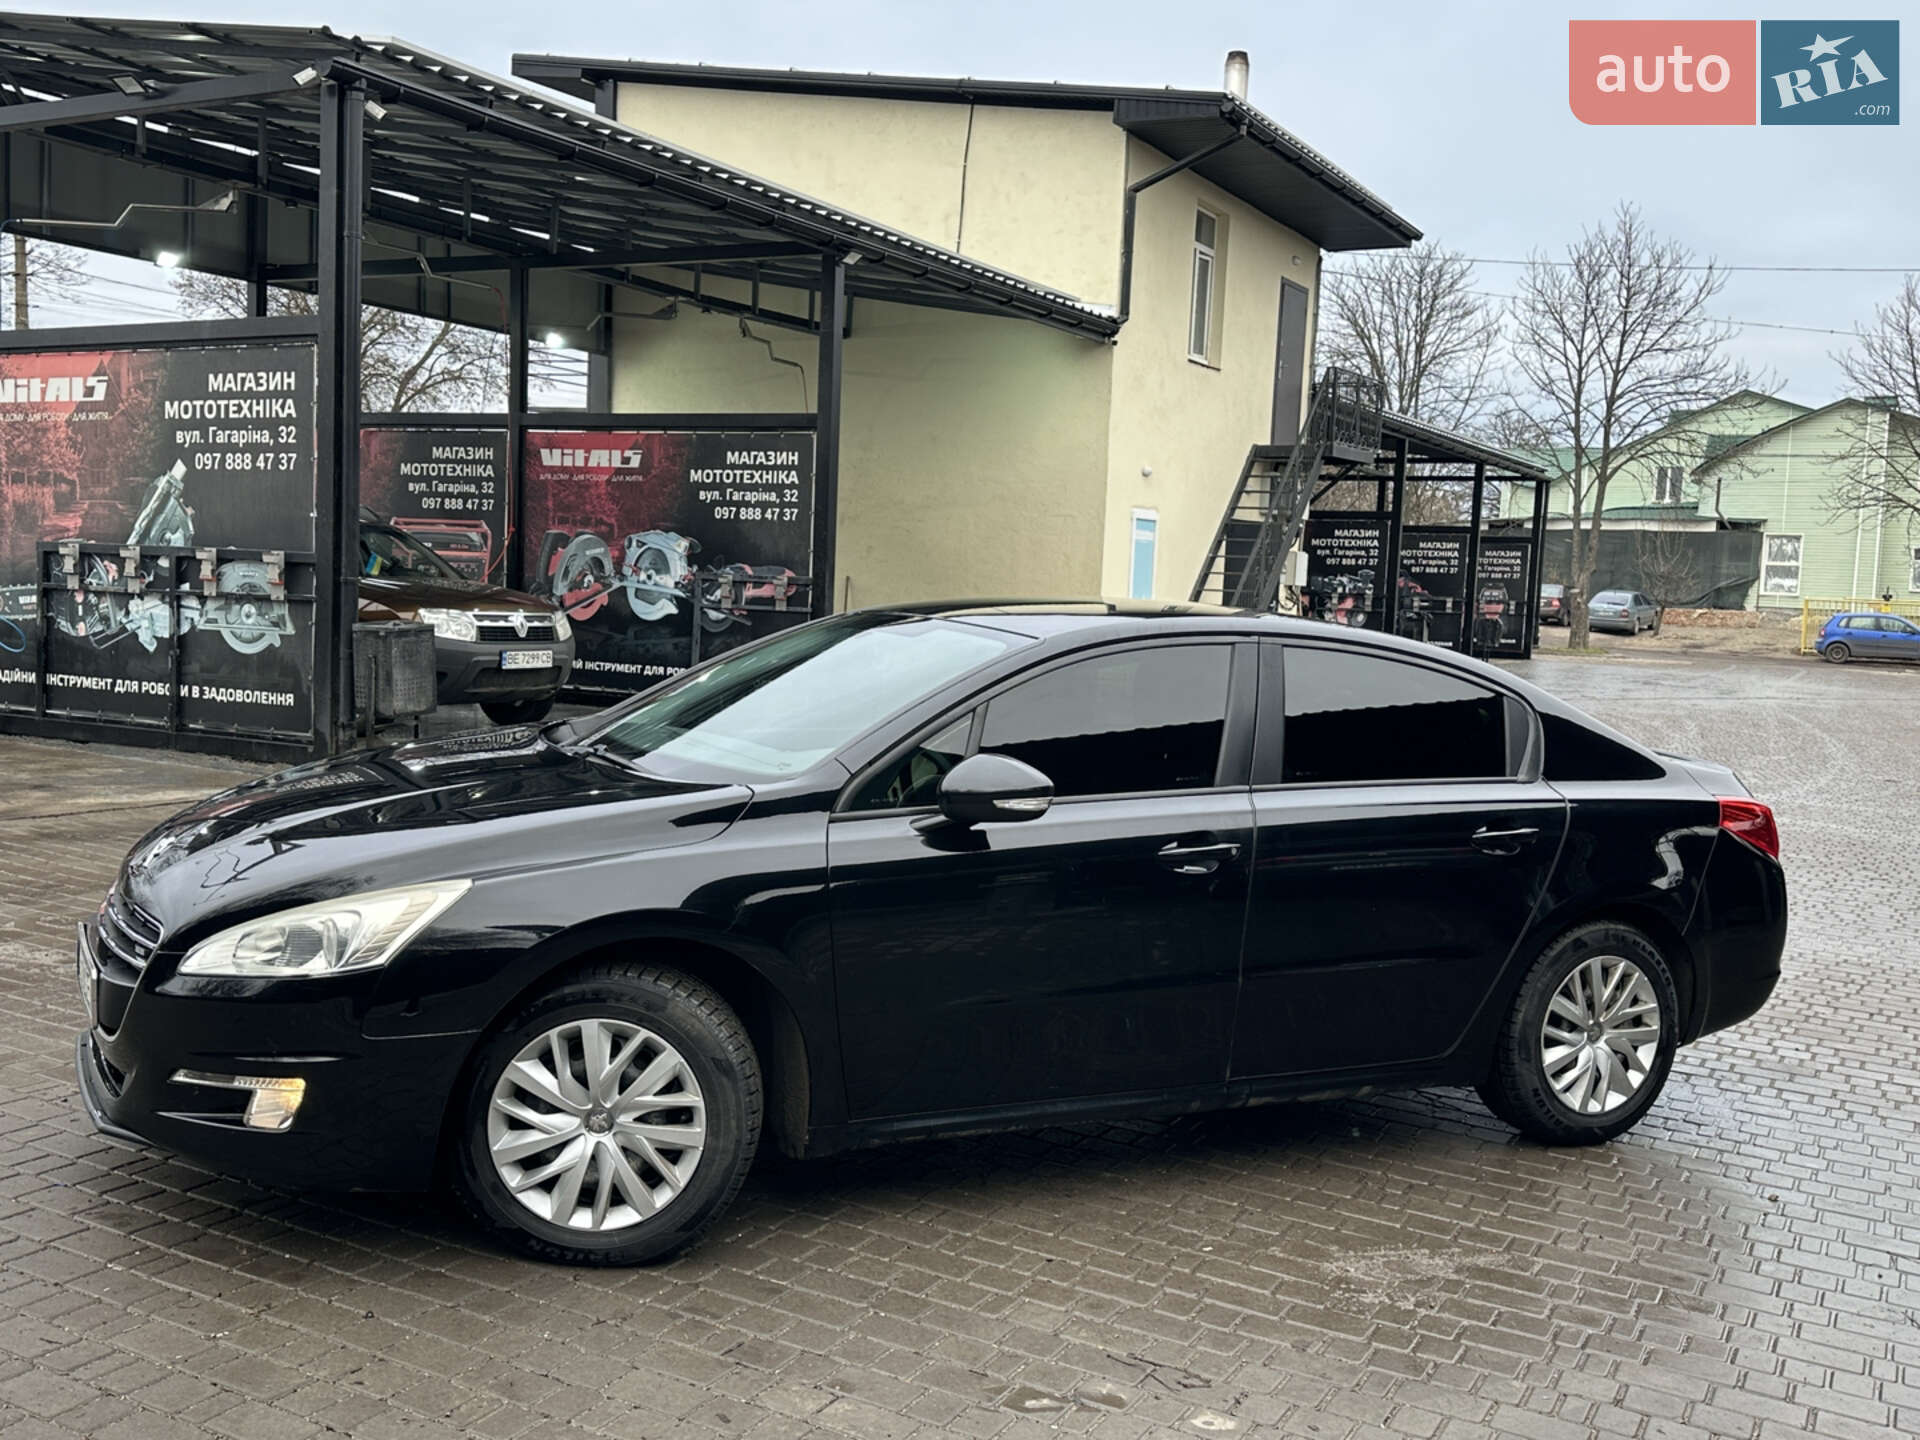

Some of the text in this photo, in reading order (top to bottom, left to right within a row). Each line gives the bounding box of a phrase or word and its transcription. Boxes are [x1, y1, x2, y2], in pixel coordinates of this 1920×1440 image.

[208, 371, 296, 393] МАГАЗИН
[164, 398, 297, 420] МОТОТЕХНІКА
[175, 425, 297, 448] вул. Гагаріна, 32
[432, 446, 494, 460] МАГАЗИН
[726, 451, 799, 465] МАГАЗИН
[195, 452, 297, 471] 097 888 47 37
[400, 463, 495, 477] МОТОТЕХНІКА
[690, 469, 799, 484] МОТОТЕХНІКА
[408, 481, 494, 495] вул. Гагаріна, 32
[699, 488, 799, 504] вул. Гагаріна, 32
[422, 497, 494, 511] 097 888 47 37
[714, 507, 799, 521] 097 888 47 37
[1334, 529, 1379, 537] МАГАЗИН
[1311, 538, 1379, 547] МОТОТЕХНІКА
[584, 661, 643, 674] ІНСТРУМЕНТ
[643, 666, 665, 676] ДЛЯ
[46, 673, 113, 691] ІНСТРУМЕНТ
[114, 680, 139, 694] ДЛЯ
[192, 685, 200, 699] В
[202, 686, 295, 707] ЗАДОВОЛЕННЯ
